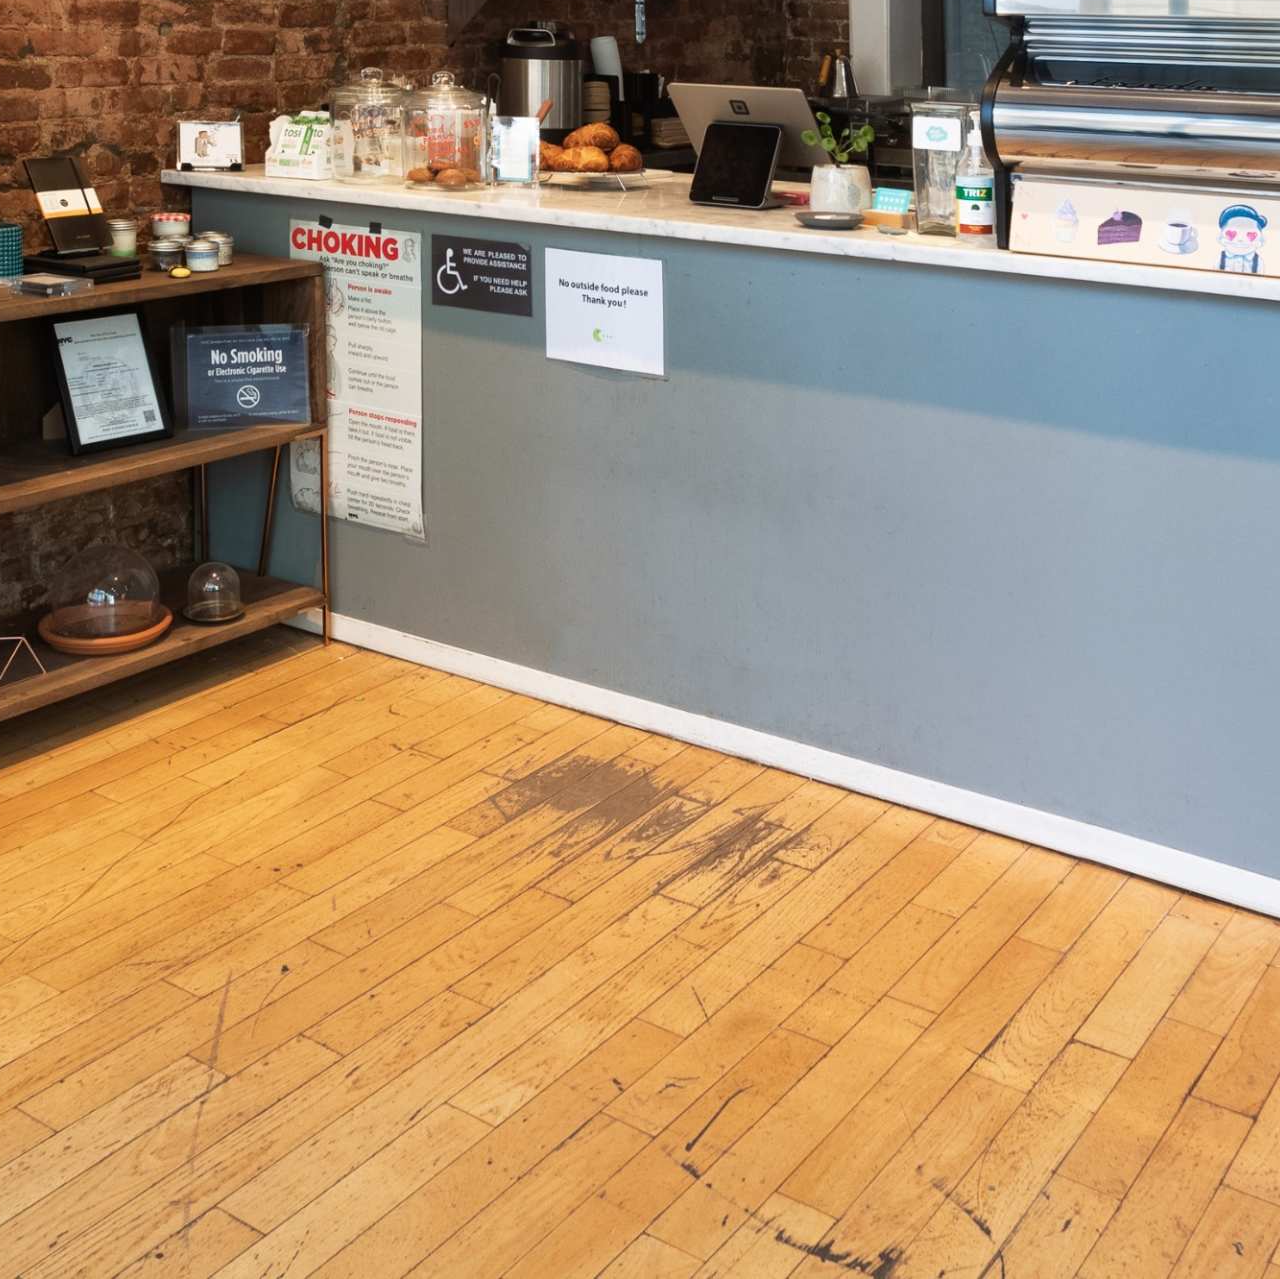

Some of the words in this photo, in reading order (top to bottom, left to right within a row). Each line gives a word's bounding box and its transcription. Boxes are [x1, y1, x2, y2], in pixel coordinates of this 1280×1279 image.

[962, 187, 987, 198] TRIZ
[291, 226, 399, 261] CHOKING
[463, 247, 472, 256] WE
[474, 250, 486, 258] ARE
[487, 251, 516, 261] PLEASED
[518, 254, 527, 262] TO
[346, 259, 357, 268] you
[463, 256, 488, 266] PROVIDE
[489, 259, 527, 271] ASSISTANCE
[345, 267, 360, 276] can't
[361, 270, 379, 279] speak
[389, 272, 413, 282] breathe
[480, 276, 493, 284] YOU
[493, 277, 510, 286] NEED
[510, 279, 528, 288] HELP
[558, 278, 569, 288] No
[570, 280, 599, 292] outside
[600, 283, 620, 294] food
[621, 286, 649, 297] please
[489, 285, 514, 295] PLEASE
[514, 288, 528, 296] ASK
[581, 294, 606, 305] Thank
[210, 349, 228, 365] No
[230, 347, 283, 365] Smoking
[207, 369, 216, 377] or
[215, 366, 246, 376] Electronic
[246, 365, 274, 375] Cigarette
[275, 364, 287, 373] Use
